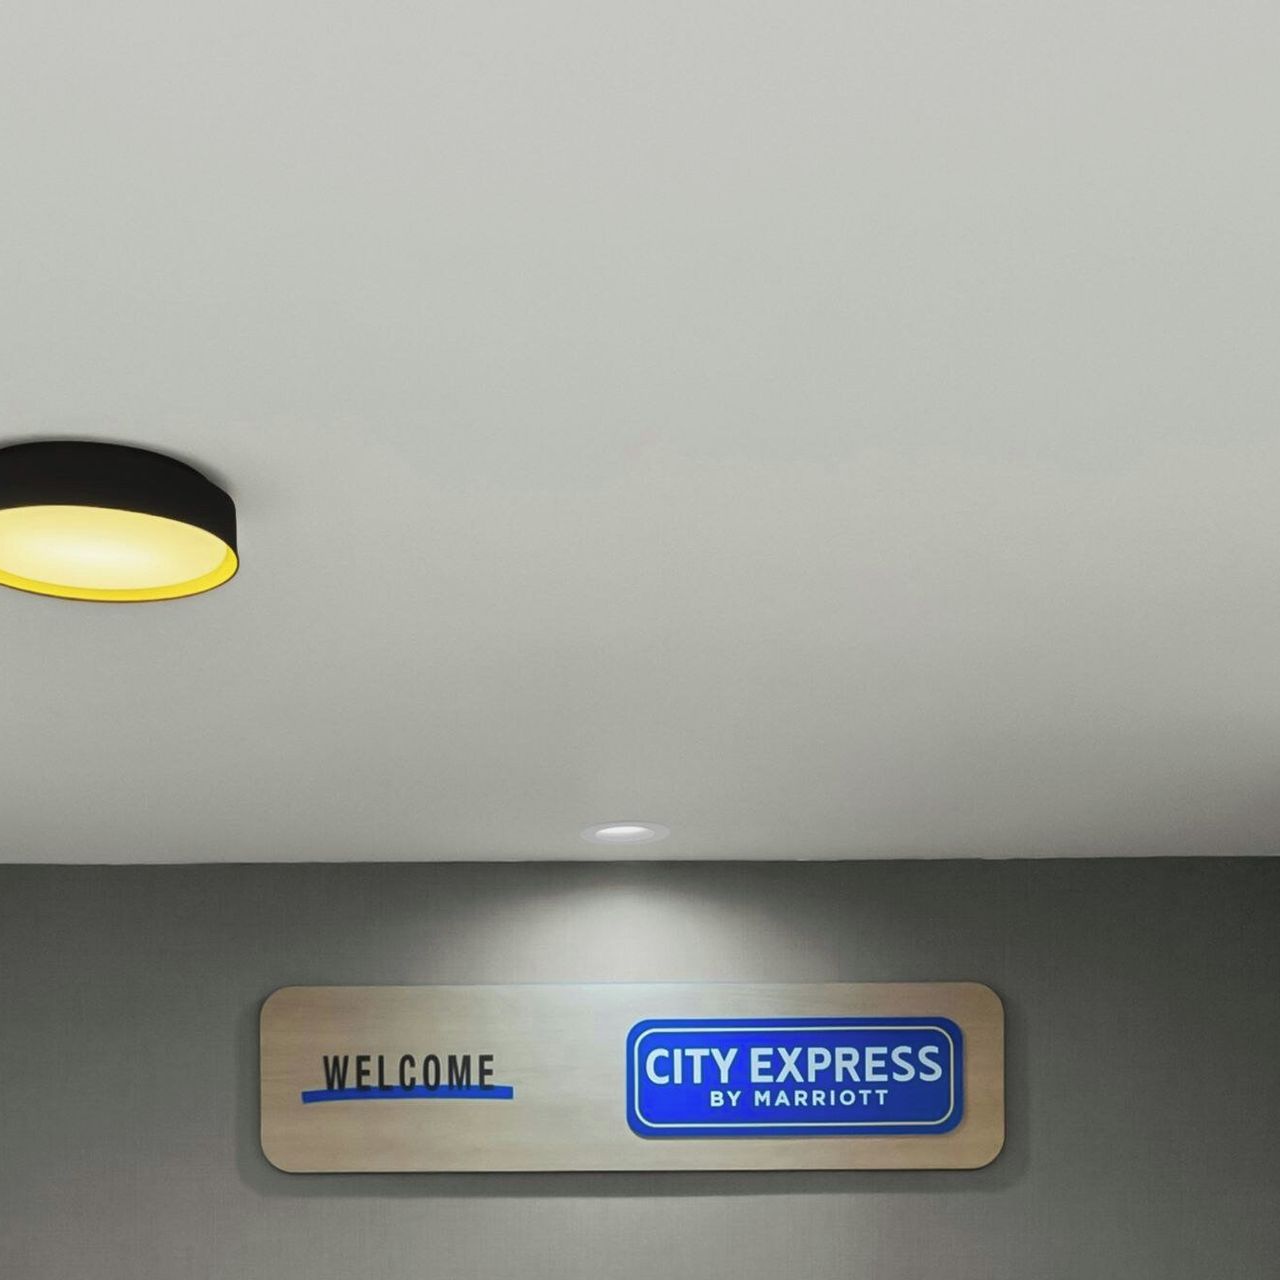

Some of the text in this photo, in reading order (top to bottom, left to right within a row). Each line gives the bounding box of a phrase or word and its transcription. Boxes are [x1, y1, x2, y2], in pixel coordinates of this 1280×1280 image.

[323, 1054, 494, 1091] WELCOME
[645, 1046, 943, 1084] CITY EXPRESS
[710, 1089, 888, 1107] BY MARRIOTT
